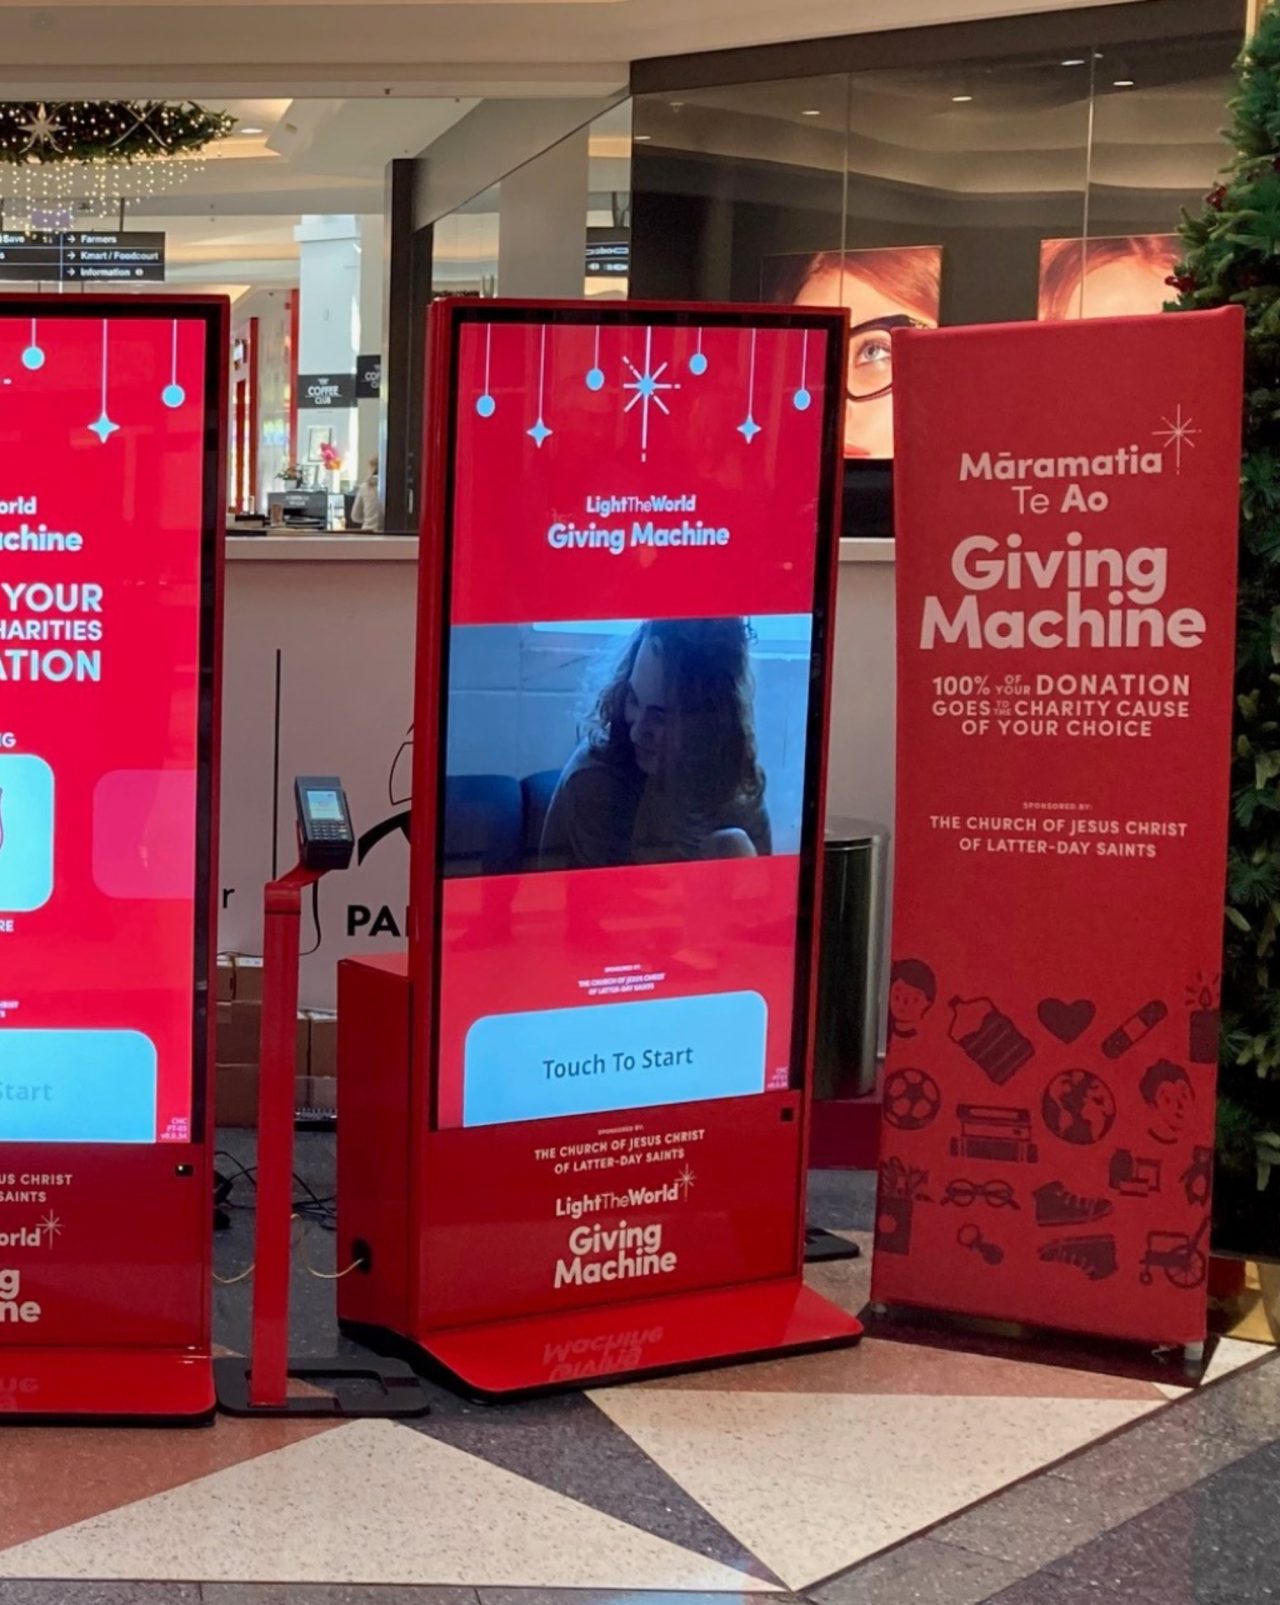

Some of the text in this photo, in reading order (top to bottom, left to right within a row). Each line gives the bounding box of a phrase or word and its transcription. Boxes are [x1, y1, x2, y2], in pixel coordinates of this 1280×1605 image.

[80, 235, 117, 244] Farmers
[80, 251, 107, 260] Kmart
[113, 251, 159, 260] Foodcourt
[80, 268, 131, 277] Information
[307, 385, 339, 396] COFFEE
[314, 397, 331, 405] CLUB
[959, 444, 1163, 481] Māramatia
[586, 495, 696, 518] LightTheWorld
[1011, 483, 1108, 514] Te Ao
[548, 521, 730, 555] Giving Machine
[951, 531, 1168, 605] Giving
[1, 583, 103, 613] YOUR
[920, 590, 1206, 650] Machine
[932, 675, 991, 696] 100%
[1004, 674, 1022, 684] OF
[1036, 674, 1190, 696] DONATION
[995, 685, 1031, 696] YOUR
[932, 700, 991, 717] GOES
[1014, 700, 1189, 718] CHARITY CAUSE
[961, 719, 1152, 737] OF YOUR CHOICE
[1022, 801, 1076, 811] SPONSORED
[930, 815, 1188, 837] THE CHURCH OF JESUS CHRIST
[959, 837, 1156, 858] OF LATTER-DAY SAINTS
[346, 905, 409, 937] PA
[543, 1046, 694, 1080] Touch To Start
[534, 1129, 705, 1160] THE CHURCH OF JESUS CHRIST
[554, 1148, 685, 1175] OF LATTER-DAY SAINTS
[20, 1173, 73, 1186] CHRIST
[555, 1182, 679, 1219] LightTheWorld
[569, 1219, 662, 1256] Giving
[553, 1248, 678, 1289] Machine
